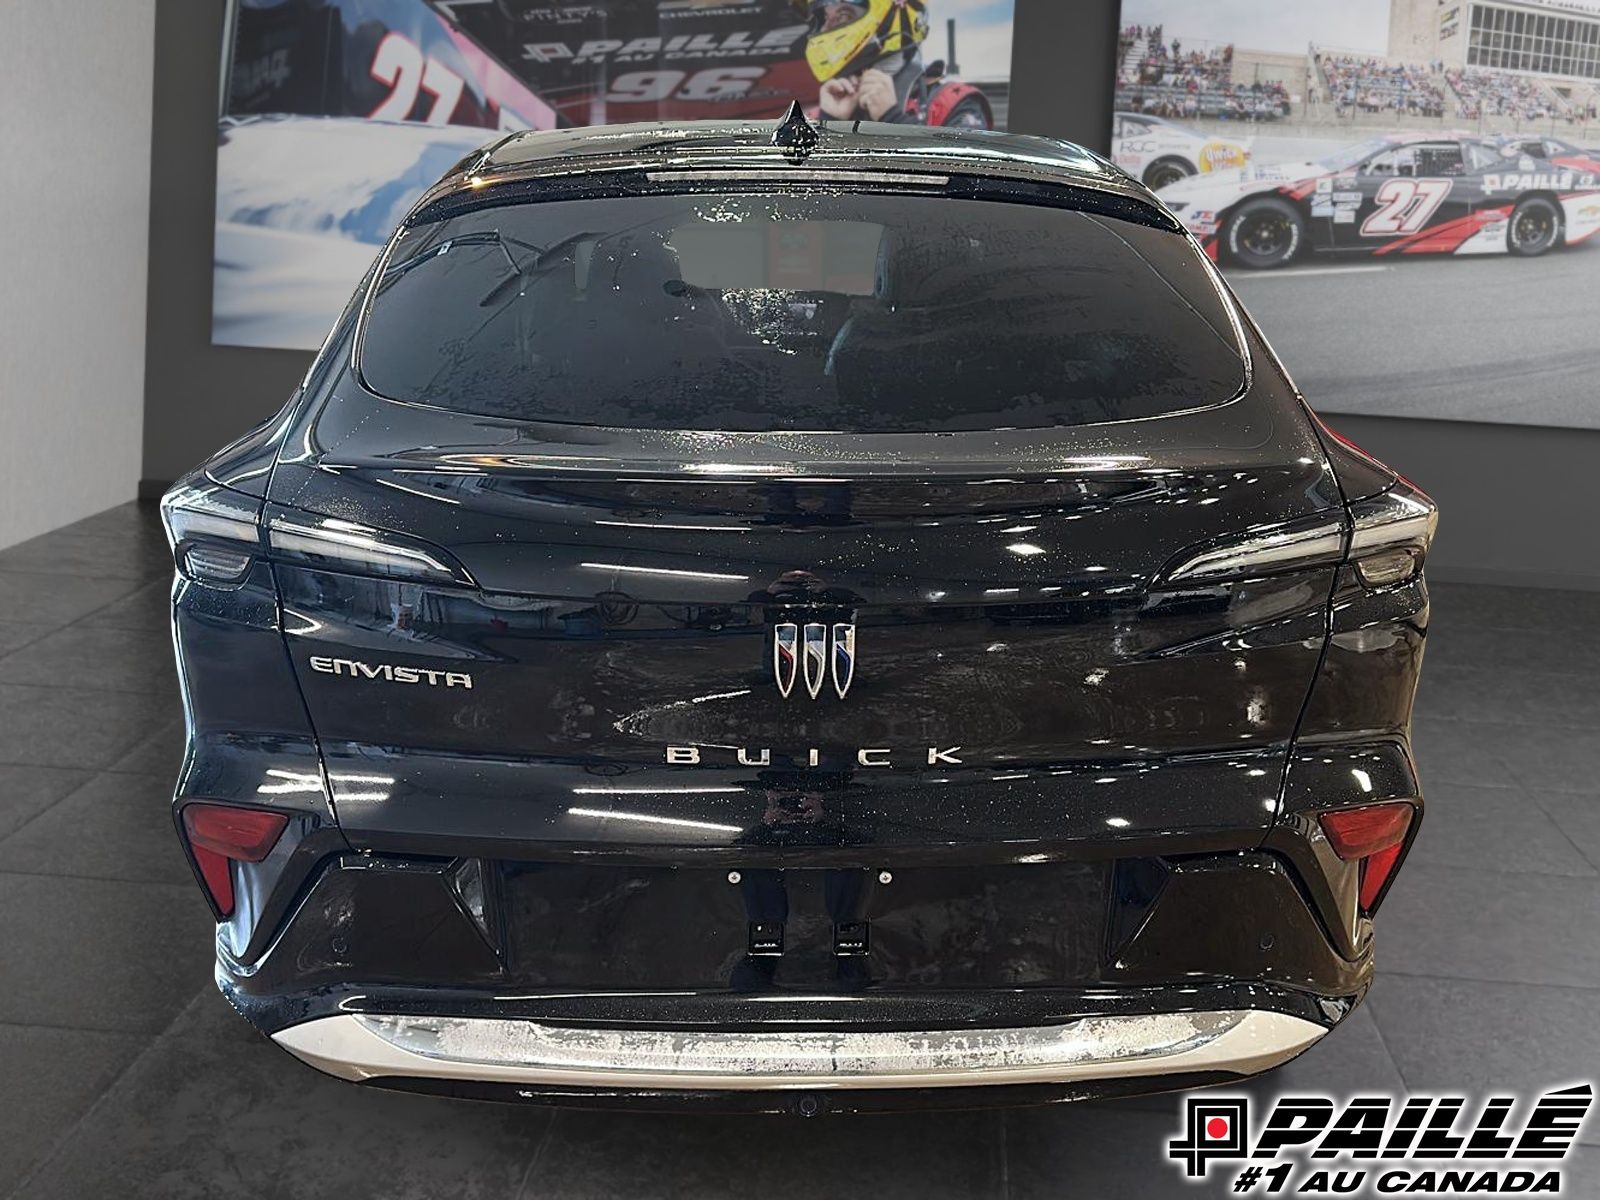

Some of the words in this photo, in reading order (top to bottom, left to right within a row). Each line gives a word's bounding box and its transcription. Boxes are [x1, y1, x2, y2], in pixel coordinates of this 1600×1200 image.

[659, 6, 762, 19] CHEVROLET
[614, 53, 654, 63] AU
[664, 47, 791, 60] CANADA
[368, 31, 465, 127] 27
[605, 66, 767, 102] 96
[1360, 178, 1453, 237] 27
[666, 746, 963, 766] BUICK
